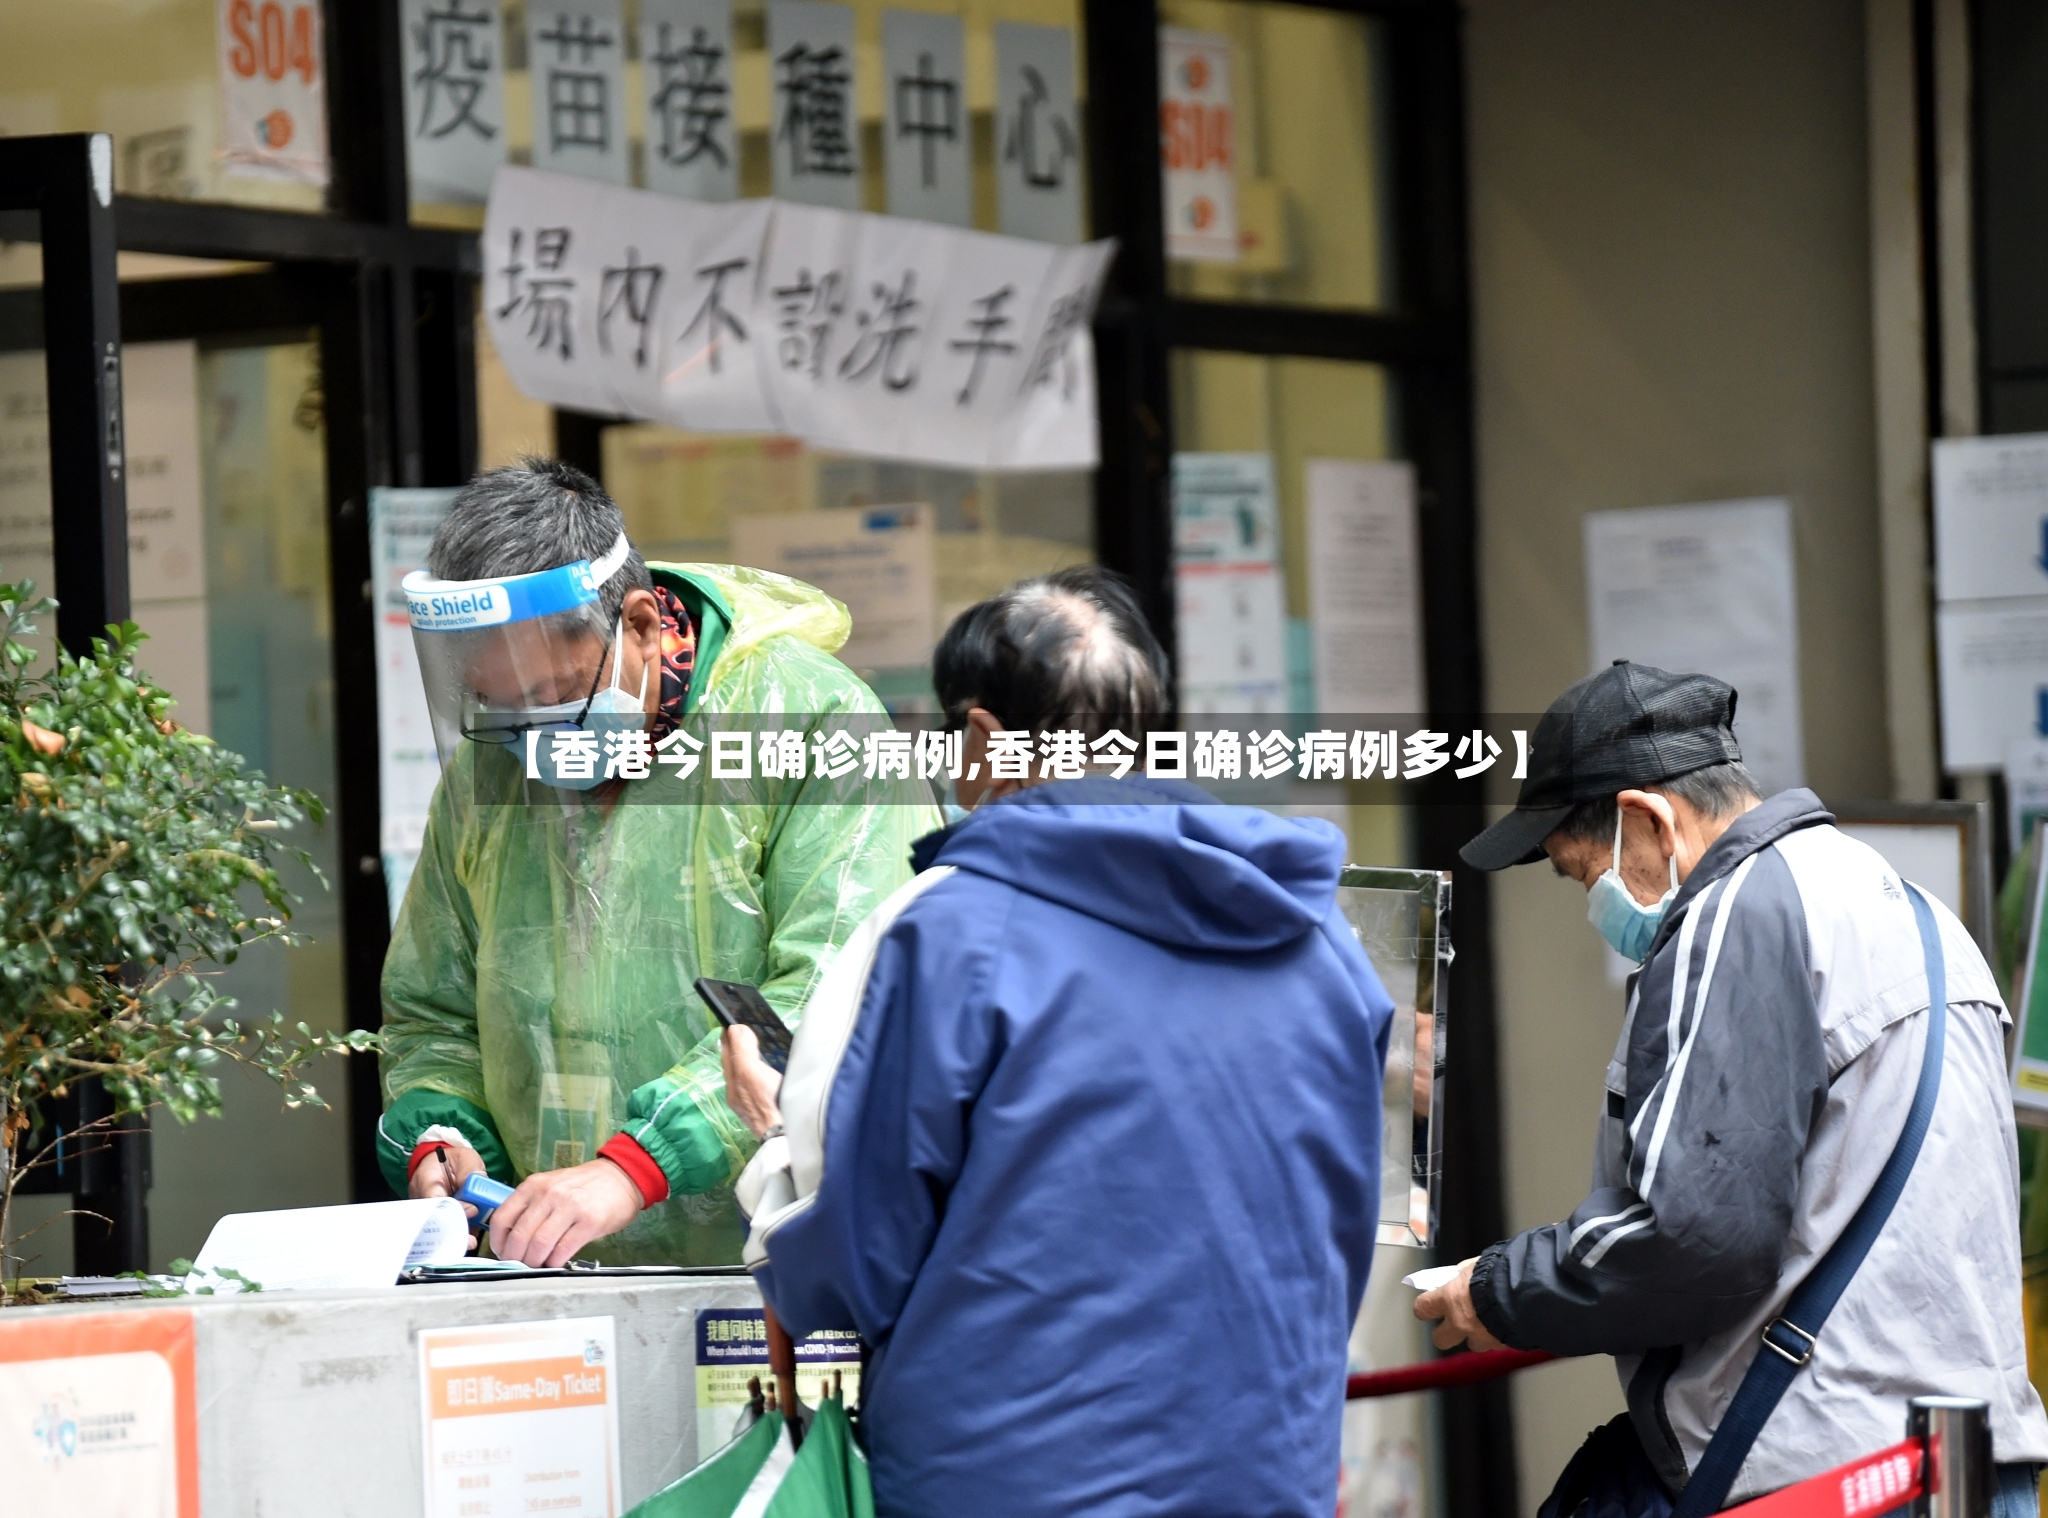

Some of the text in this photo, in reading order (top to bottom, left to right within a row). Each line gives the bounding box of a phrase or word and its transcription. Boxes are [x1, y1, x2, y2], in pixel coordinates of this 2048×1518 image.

[414, 1, 1076, 190] 疫苗接種中心
[407, 591, 493, 616] ace Shield
[434, 615, 477, 629] protection
[706, 1346, 724, 1357] When
[725, 1344, 747, 1356] should
[804, 1343, 834, 1354] COVID-19
[563, 1370, 602, 1395] Ticket
